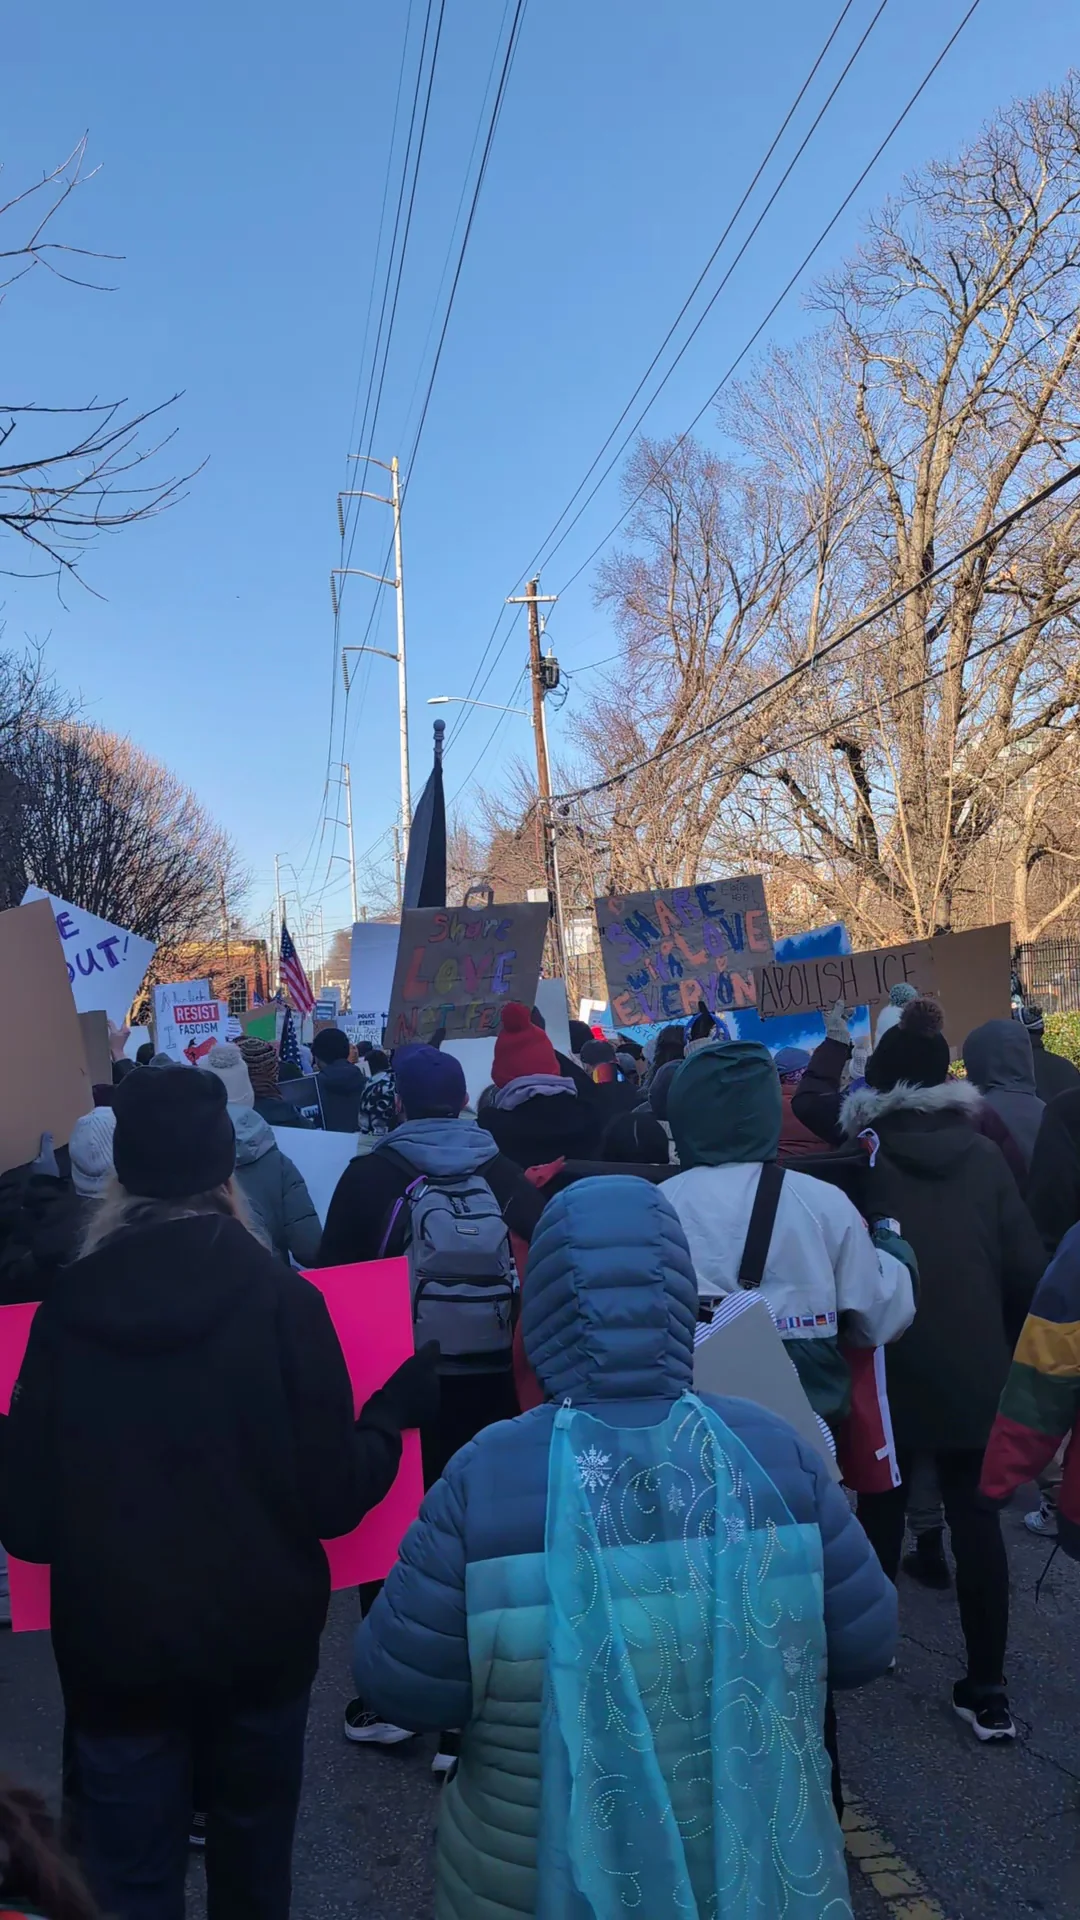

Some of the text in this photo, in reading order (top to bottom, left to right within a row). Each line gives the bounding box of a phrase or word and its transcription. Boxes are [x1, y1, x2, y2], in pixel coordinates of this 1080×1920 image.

[428, 912, 514, 945] Share
[673, 909, 769, 965] LOVE
[402, 946, 517, 1001] LOVE
[760, 952, 917, 1012] ABOLISH ICE
[175, 1004, 217, 1022] RESIST
[357, 1012, 376, 1020] POLICE
[612, 970, 757, 1025] EVERYON
[179, 1021, 219, 1035] FASCISM
